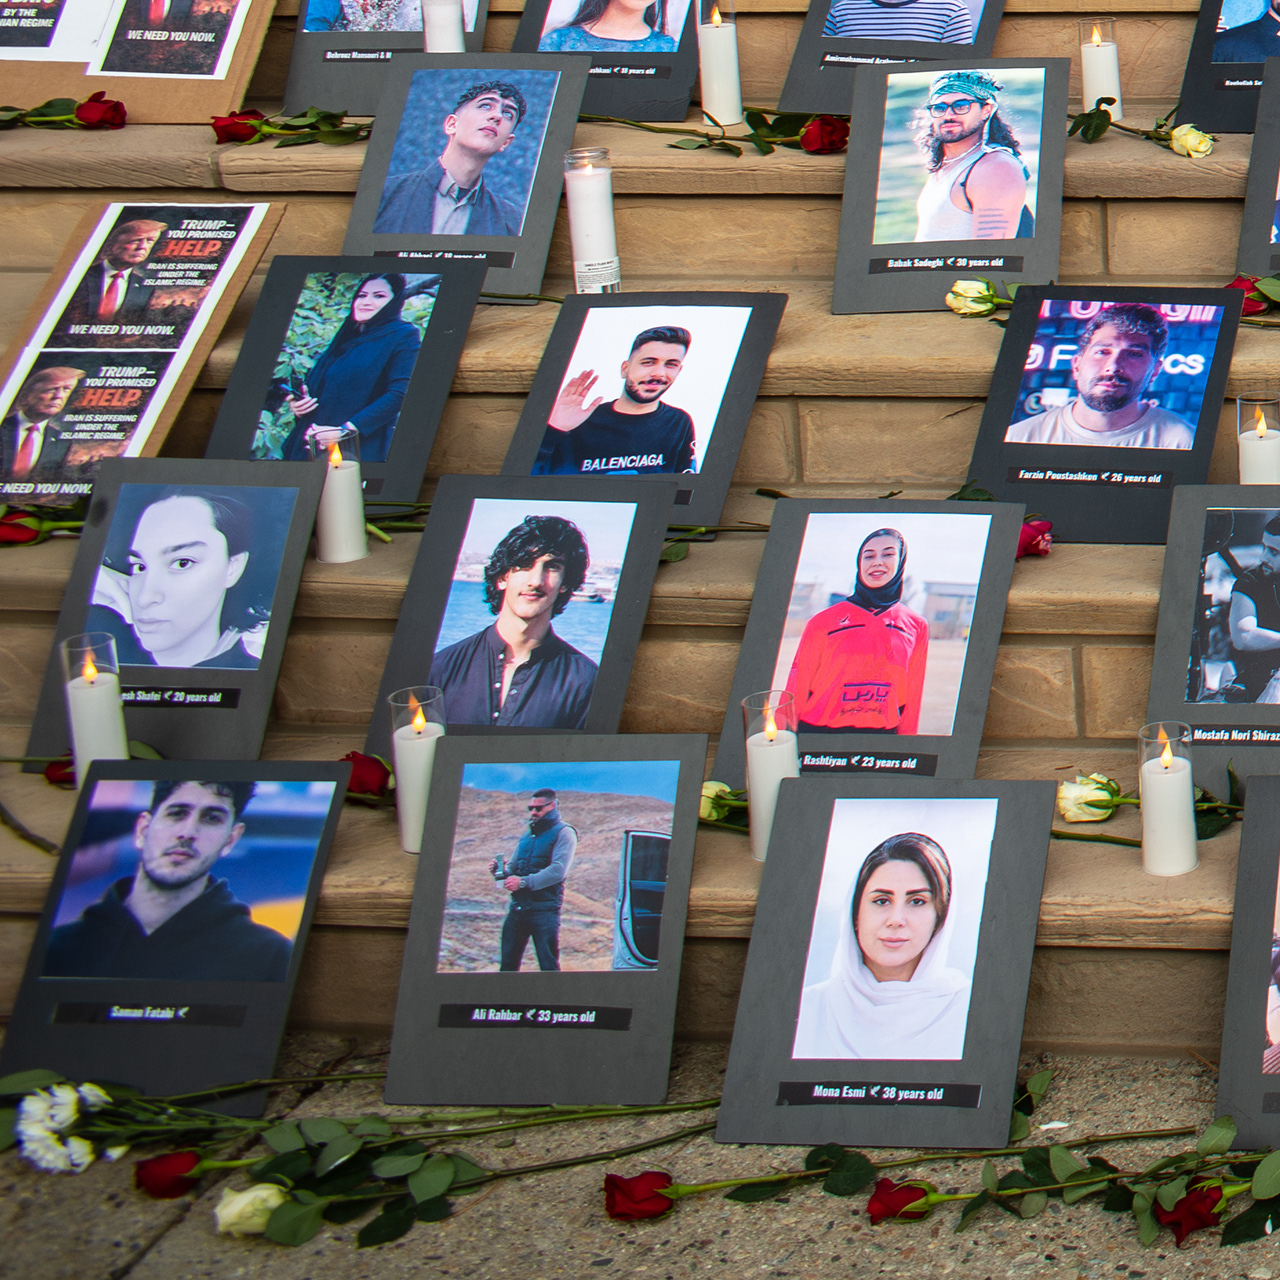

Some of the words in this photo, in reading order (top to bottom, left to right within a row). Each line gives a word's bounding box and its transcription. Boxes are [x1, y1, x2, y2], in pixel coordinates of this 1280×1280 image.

[3, 8, 17, 17] BY
[19, 8, 38, 17] THE
[20, 18, 55, 27] REGIME
[167, 230, 188, 239] YOU
[187, 230, 237, 239] PROMISED
[164, 240, 222, 257] HELP
[69, 324, 90, 334] WE
[88, 324, 120, 335] NEED
[120, 325, 145, 335] YOU
[144, 325, 176, 335] NOW.
[580, 453, 665, 472] BALENCIAGA
[472, 1008, 487, 1021] Ali
[487, 1008, 522, 1021] Rahbar
[536, 1010, 551, 1022] 33
[552, 1011, 579, 1023] years
[579, 1010, 596, 1022] old
[812, 1084, 840, 1098] Mona
[841, 1086, 867, 1099] Esmi
[882, 1087, 896, 1099] 38
[897, 1088, 925, 1101] years
[926, 1088, 944, 1100] old
